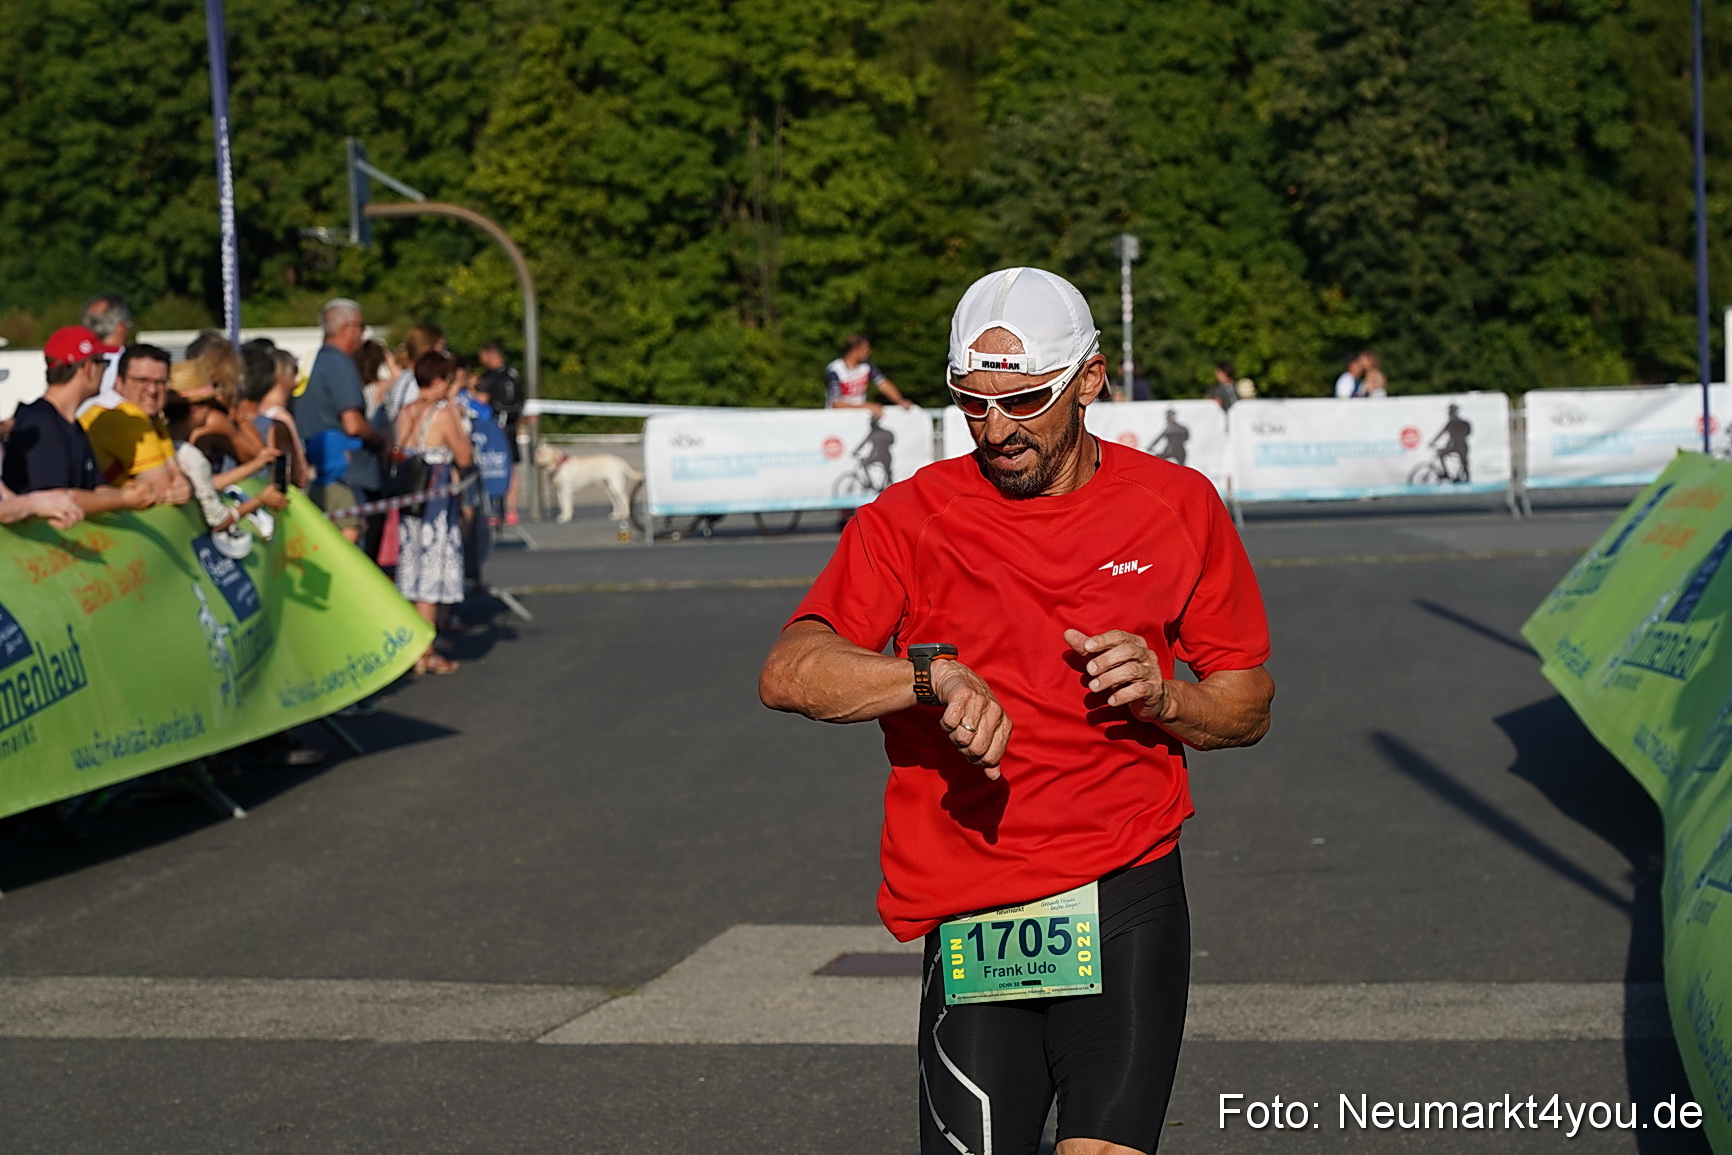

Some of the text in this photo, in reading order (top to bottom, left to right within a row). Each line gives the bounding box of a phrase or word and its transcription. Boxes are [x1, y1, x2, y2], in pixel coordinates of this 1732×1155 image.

[981, 358, 1020, 370] IRONMAN
[1111, 559, 1139, 577] DEHN
[967, 916, 1073, 962] 1705
[1076, 921, 1093, 977] 2022
[950, 938, 965, 980] RUN
[983, 960, 1057, 979] Frank Udo
